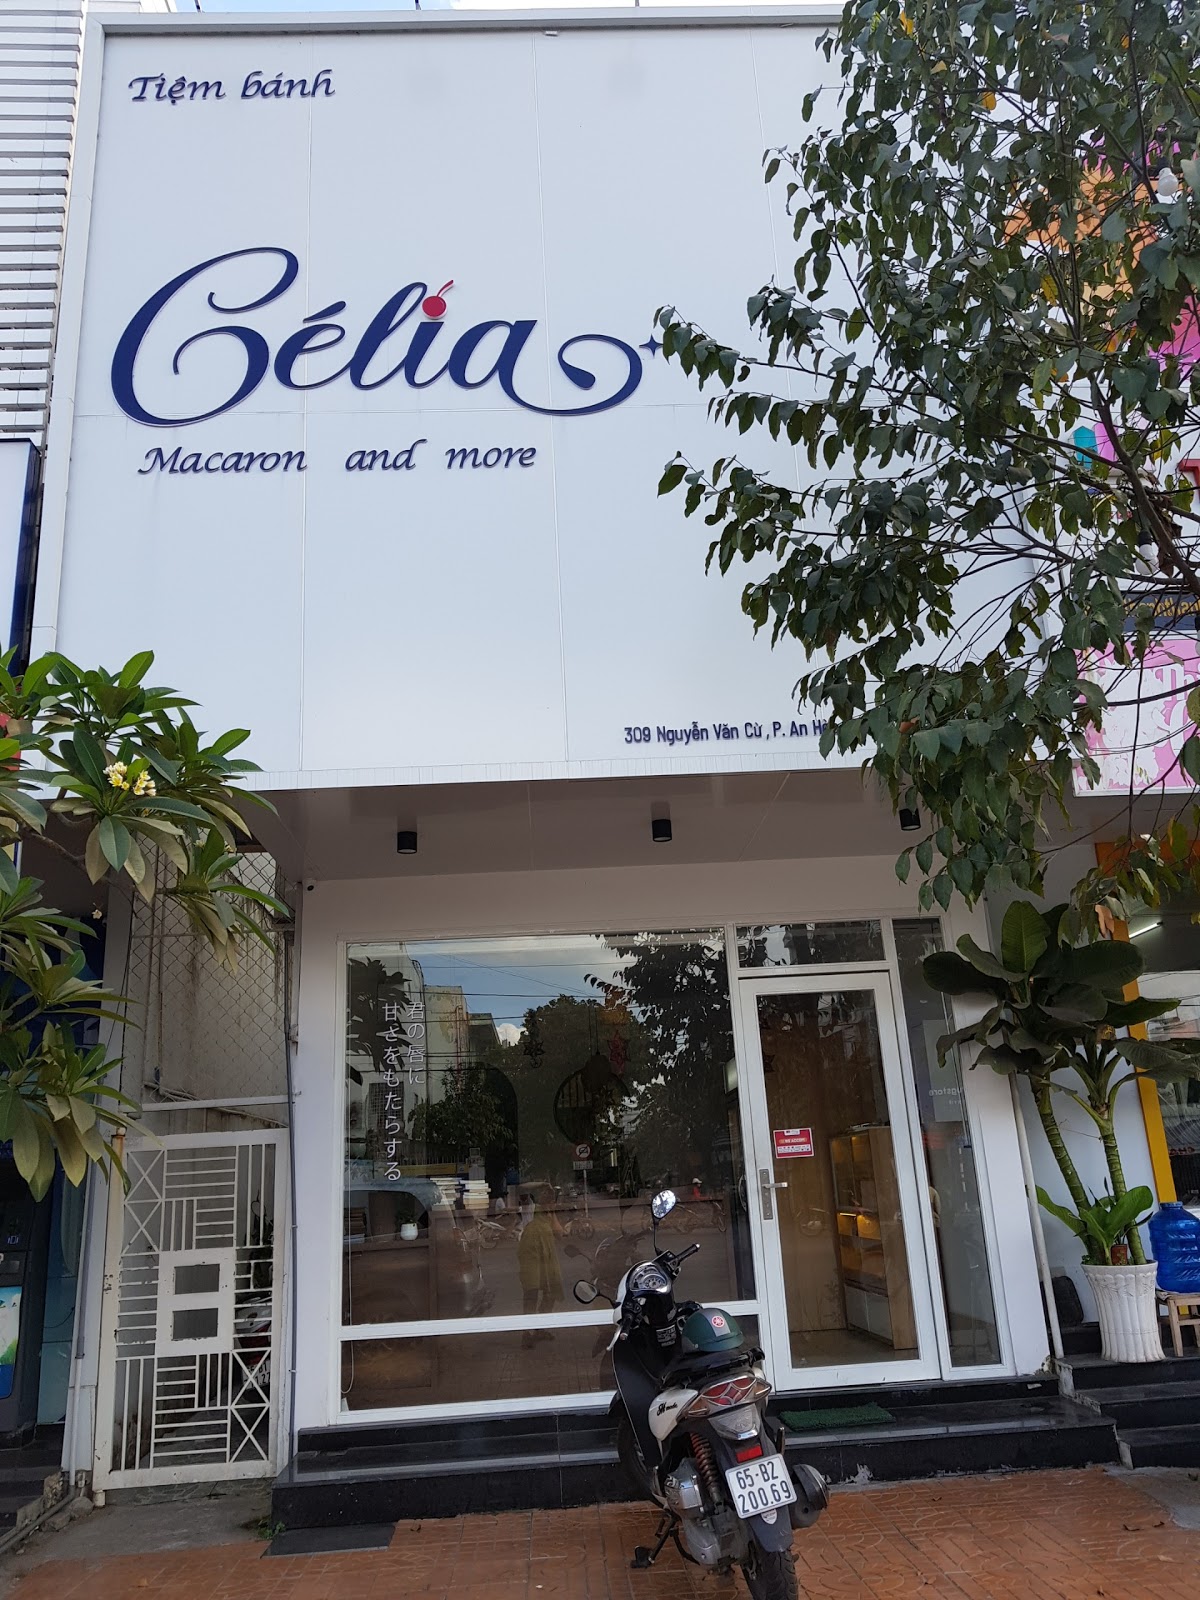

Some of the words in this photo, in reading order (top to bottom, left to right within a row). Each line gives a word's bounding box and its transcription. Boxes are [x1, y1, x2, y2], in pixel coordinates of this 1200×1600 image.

[129, 73, 225, 105] Tiệm
[241, 69, 335, 99] bánh
[111, 247, 643, 427] Célia
[138, 447, 307, 474] Macaron
[345, 439, 427, 471] and
[445, 448, 536, 469] more
[624, 727, 651, 744] 309
[657, 721, 709, 746] Nguyễn
[713, 723, 739, 740] Văn
[790, 721, 808, 737] An
[406, 1001, 426, 1085] 君の唇に
[382, 1002, 402, 1181] 甘さをもたらする
[735, 1461, 779, 1490] 65-B2
[737, 1480, 792, 1514] 200.69
